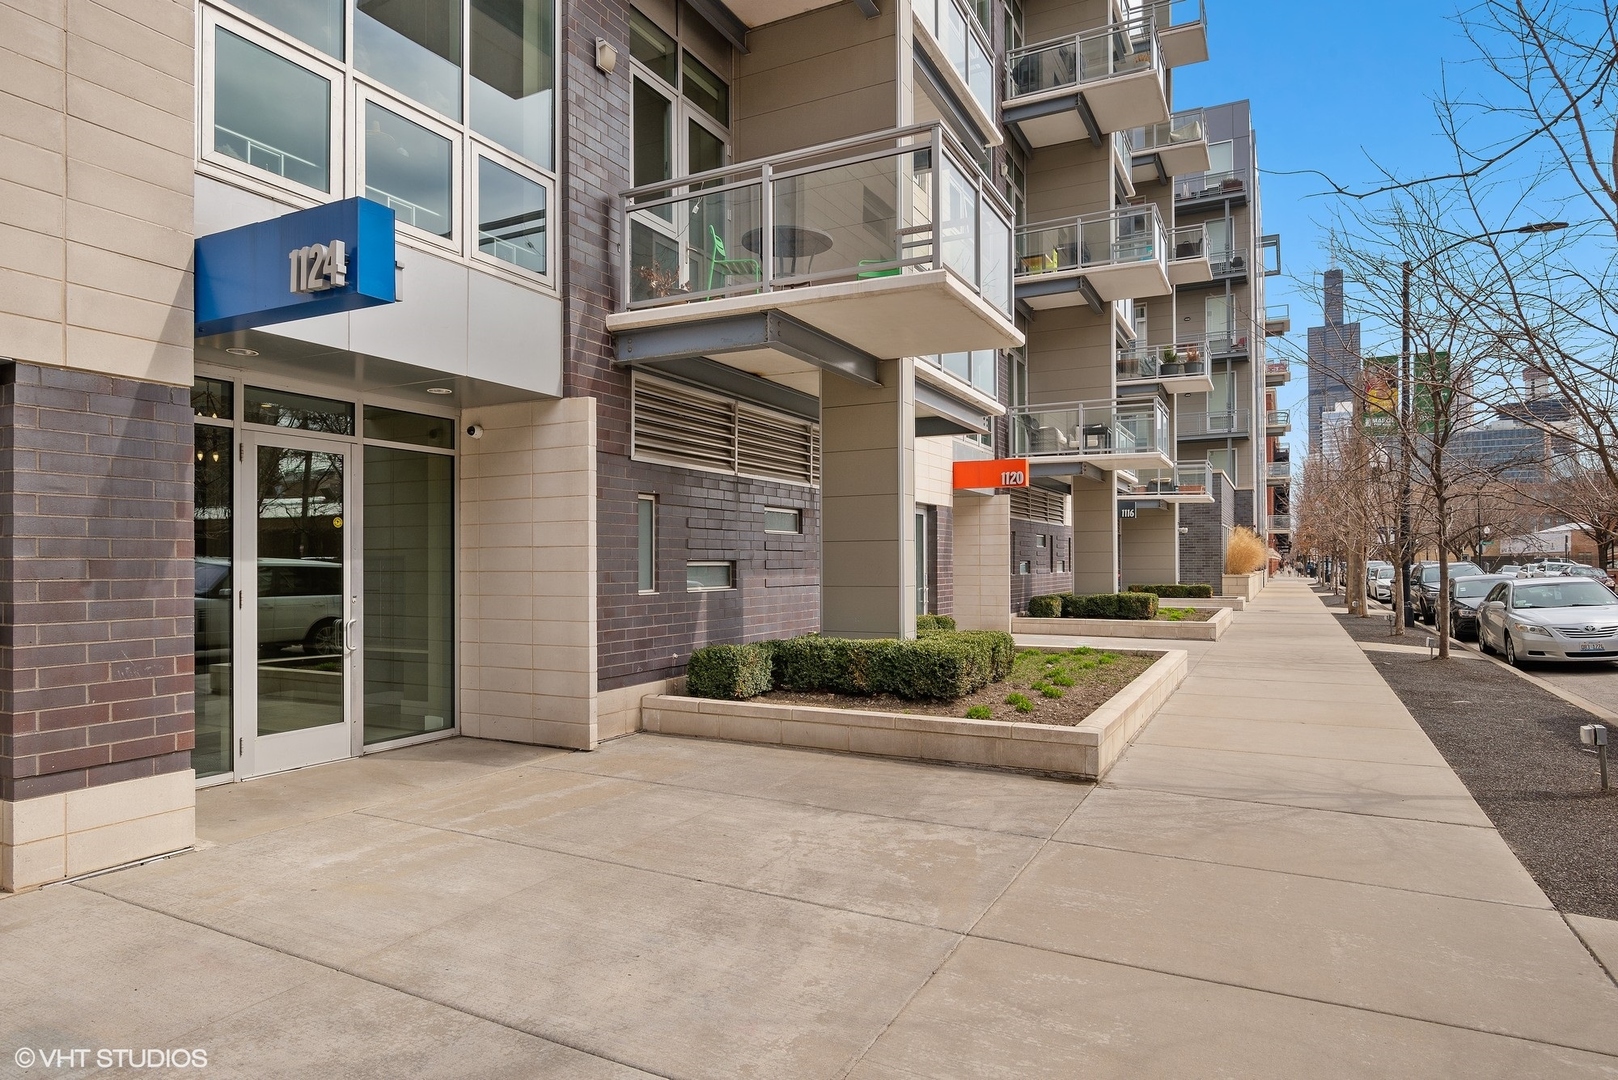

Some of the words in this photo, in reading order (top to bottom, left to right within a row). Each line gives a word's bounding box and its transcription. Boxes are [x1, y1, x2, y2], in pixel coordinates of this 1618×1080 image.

[289, 239, 346, 294] 1124
[1001, 471, 1024, 486] 1120
[1121, 509, 1135, 518] 1116
